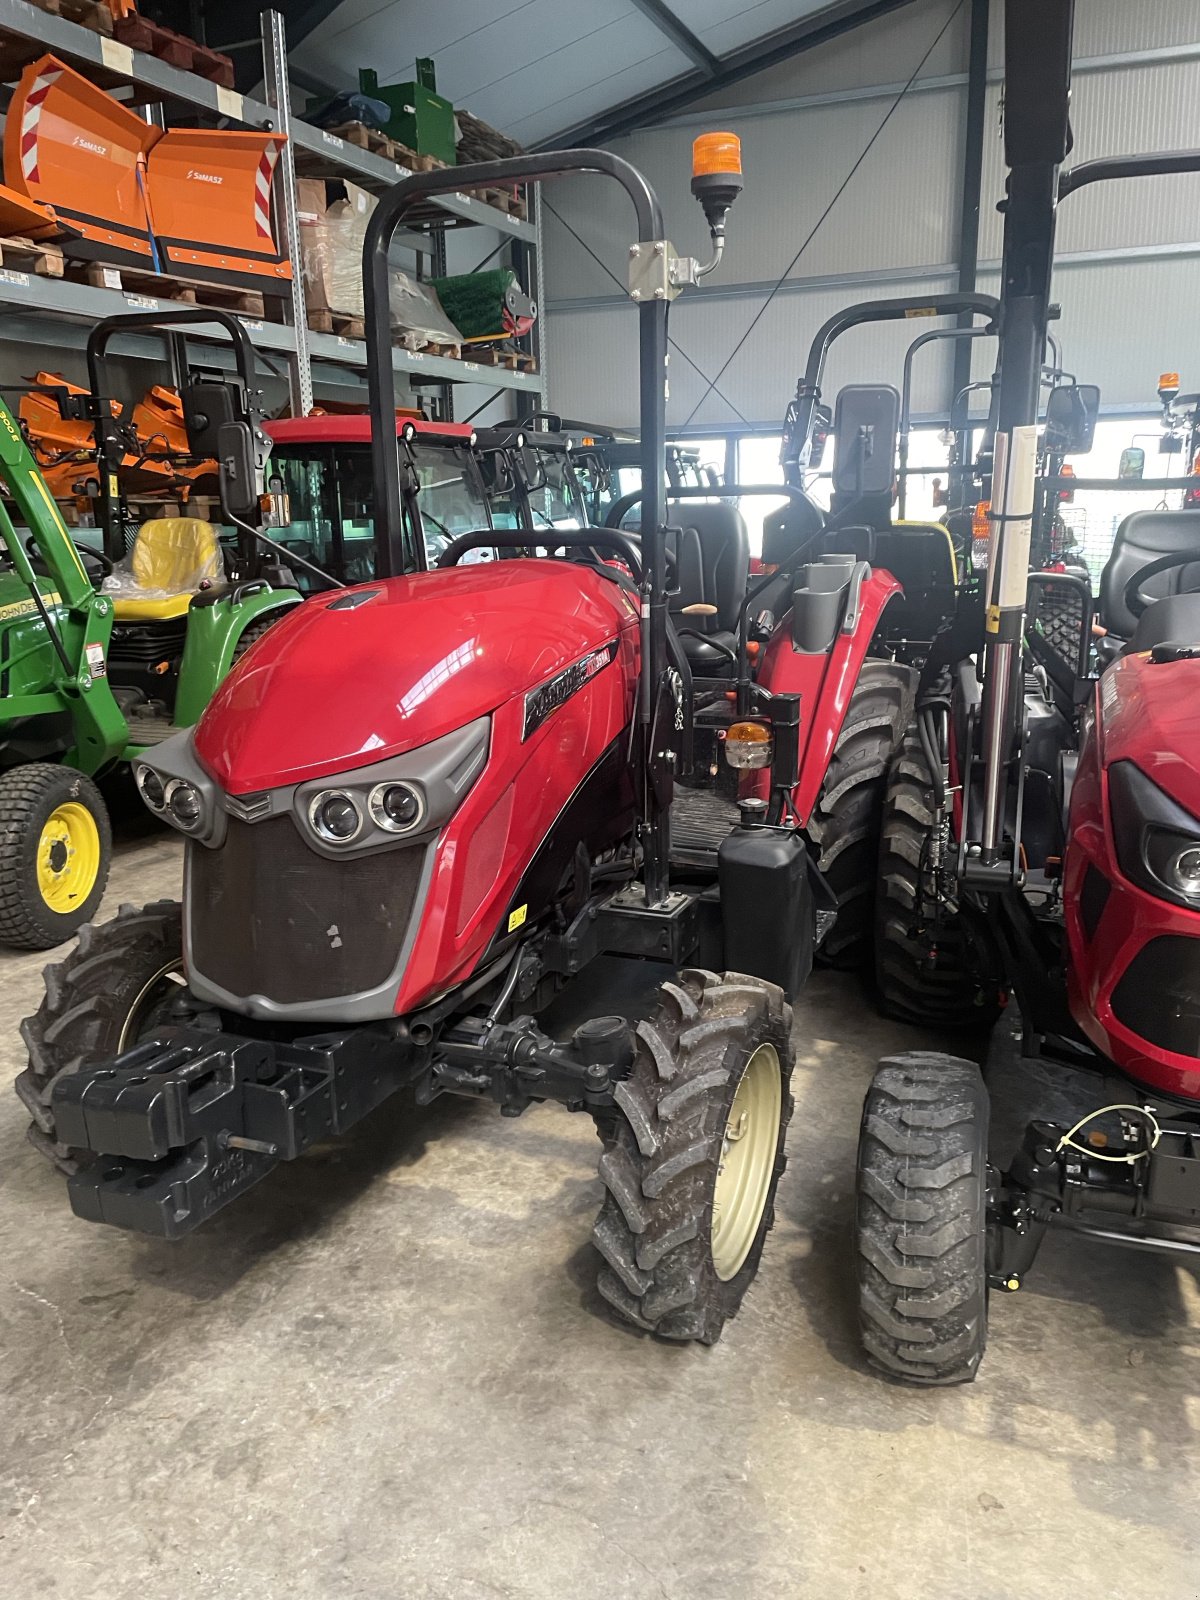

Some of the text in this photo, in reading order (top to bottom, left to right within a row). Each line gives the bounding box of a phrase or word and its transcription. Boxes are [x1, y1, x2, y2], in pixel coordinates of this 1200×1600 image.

[79, 139, 107, 155] SaMASZ
[193, 172, 223, 185] SaMASZ
[20, 598, 49, 613] DEEE
